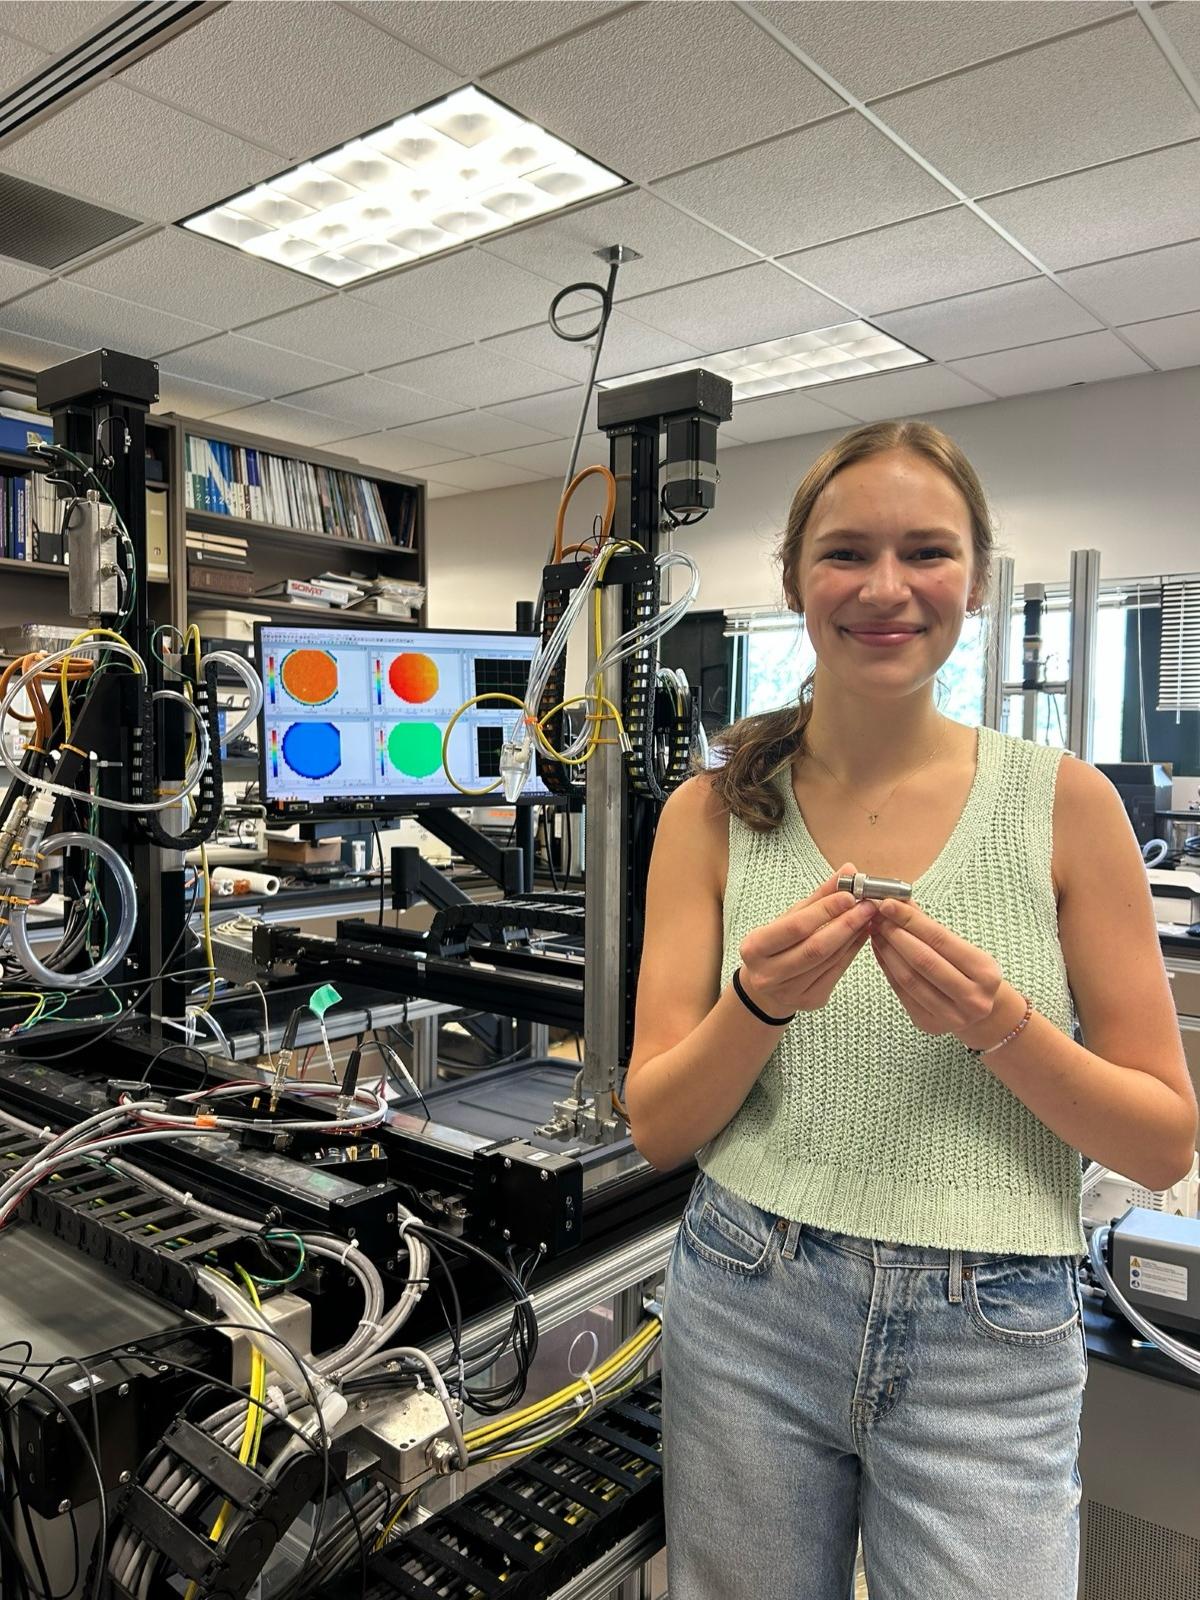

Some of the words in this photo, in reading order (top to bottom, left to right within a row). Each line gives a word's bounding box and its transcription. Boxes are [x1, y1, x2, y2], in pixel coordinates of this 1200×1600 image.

[205, 496, 211, 504] 2
[212, 496, 217, 504] 1
[219, 497, 225, 505] 2
[245, 504, 251, 512] 2
